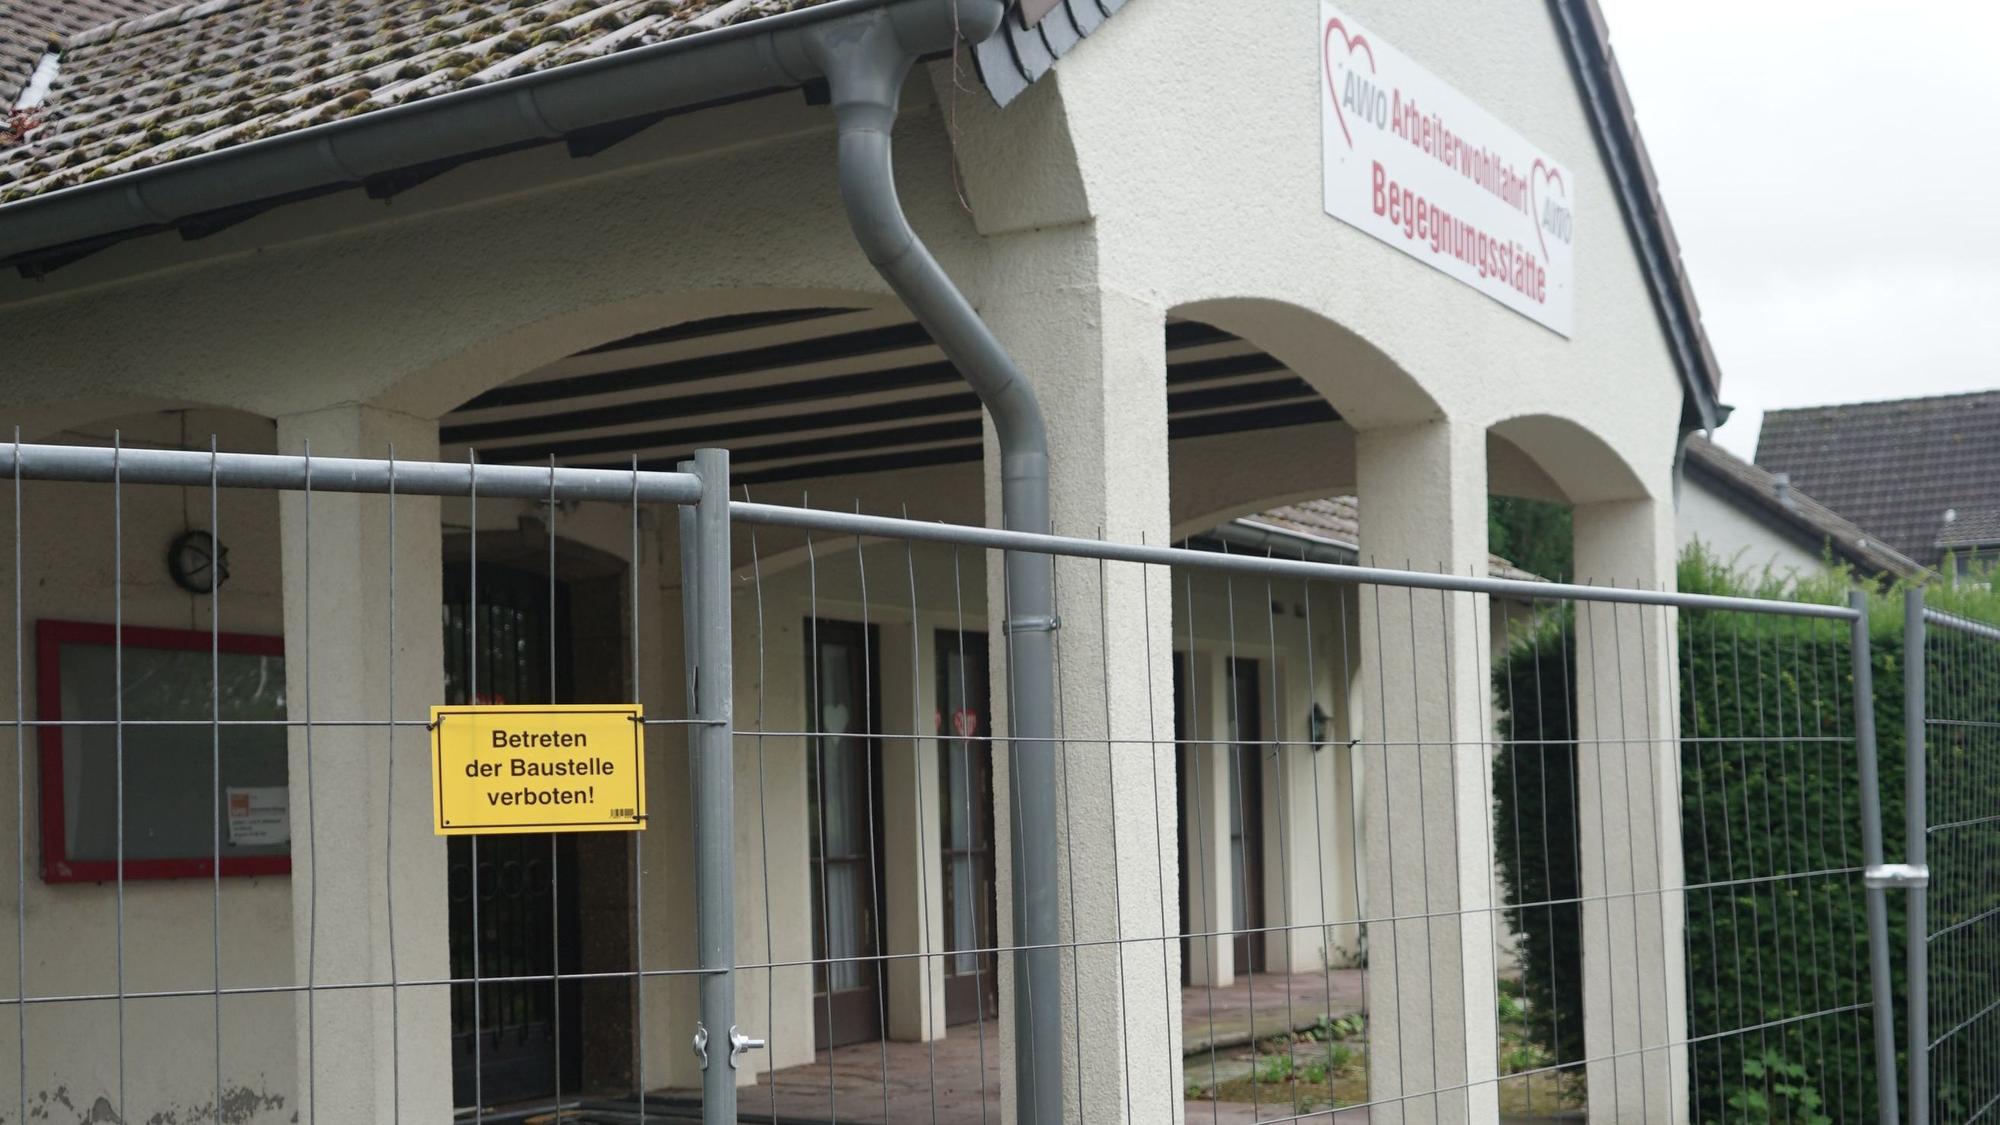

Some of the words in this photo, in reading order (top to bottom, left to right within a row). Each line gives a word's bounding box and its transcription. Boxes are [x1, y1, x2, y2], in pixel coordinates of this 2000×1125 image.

[1343, 69, 1388, 131] AWO
[1392, 87, 1528, 216] Arbeiterwohlfahrt
[1371, 159, 1546, 305] Begegnungsstätte
[492, 729, 587, 748] Betreten
[465, 759, 503, 778] der
[510, 757, 615, 777] Baustelle
[487, 786, 594, 806] verboten!
